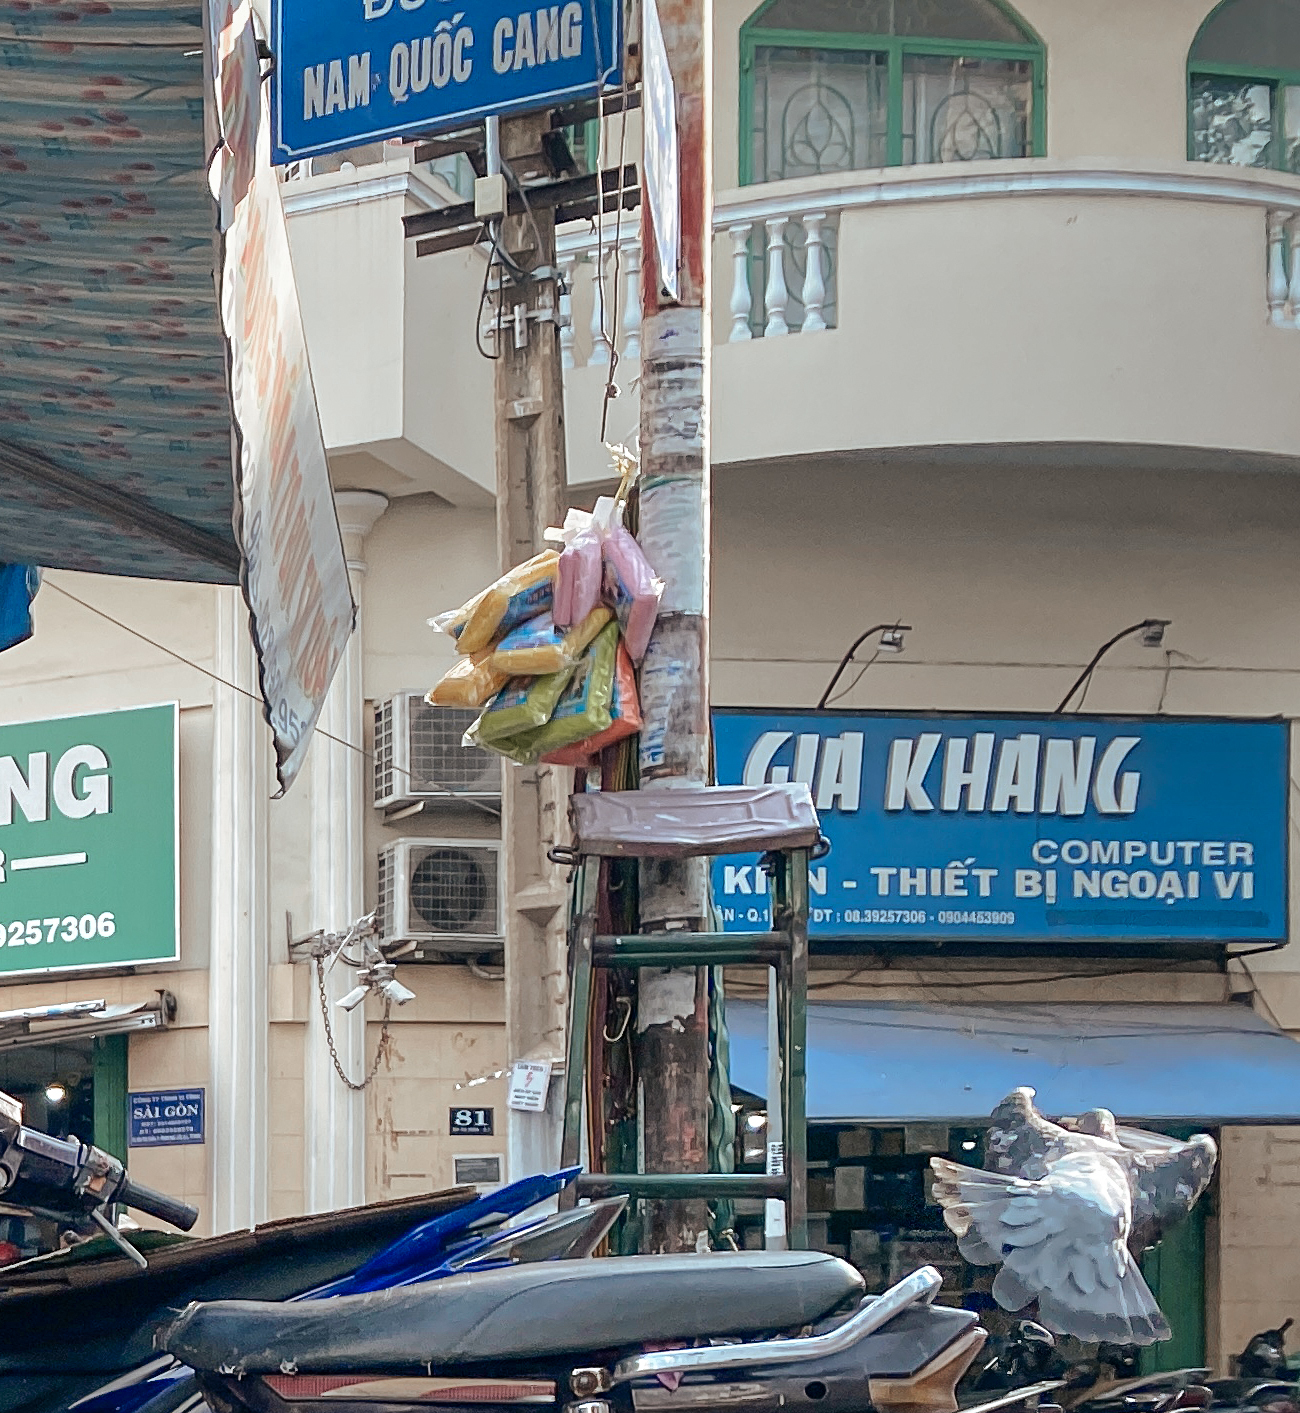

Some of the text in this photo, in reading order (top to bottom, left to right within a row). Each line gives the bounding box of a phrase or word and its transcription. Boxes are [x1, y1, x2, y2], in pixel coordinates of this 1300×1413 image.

[303, 2, 583, 121] NAM QUỐC CANG
[743, 730, 1142, 816] GIA KHANG
[1031, 839, 1254, 867] COMPUTER
[724, 865, 828, 896] KIN
[869, 857, 999, 898] THIẾT
[1015, 868, 1057, 903] BỊ
[1072, 868, 1199, 904] NGOẠI
[1214, 870, 1254, 900] VI
[164, 1101, 199, 1118] GÒN
[454, 1109, 489, 1127] 81
